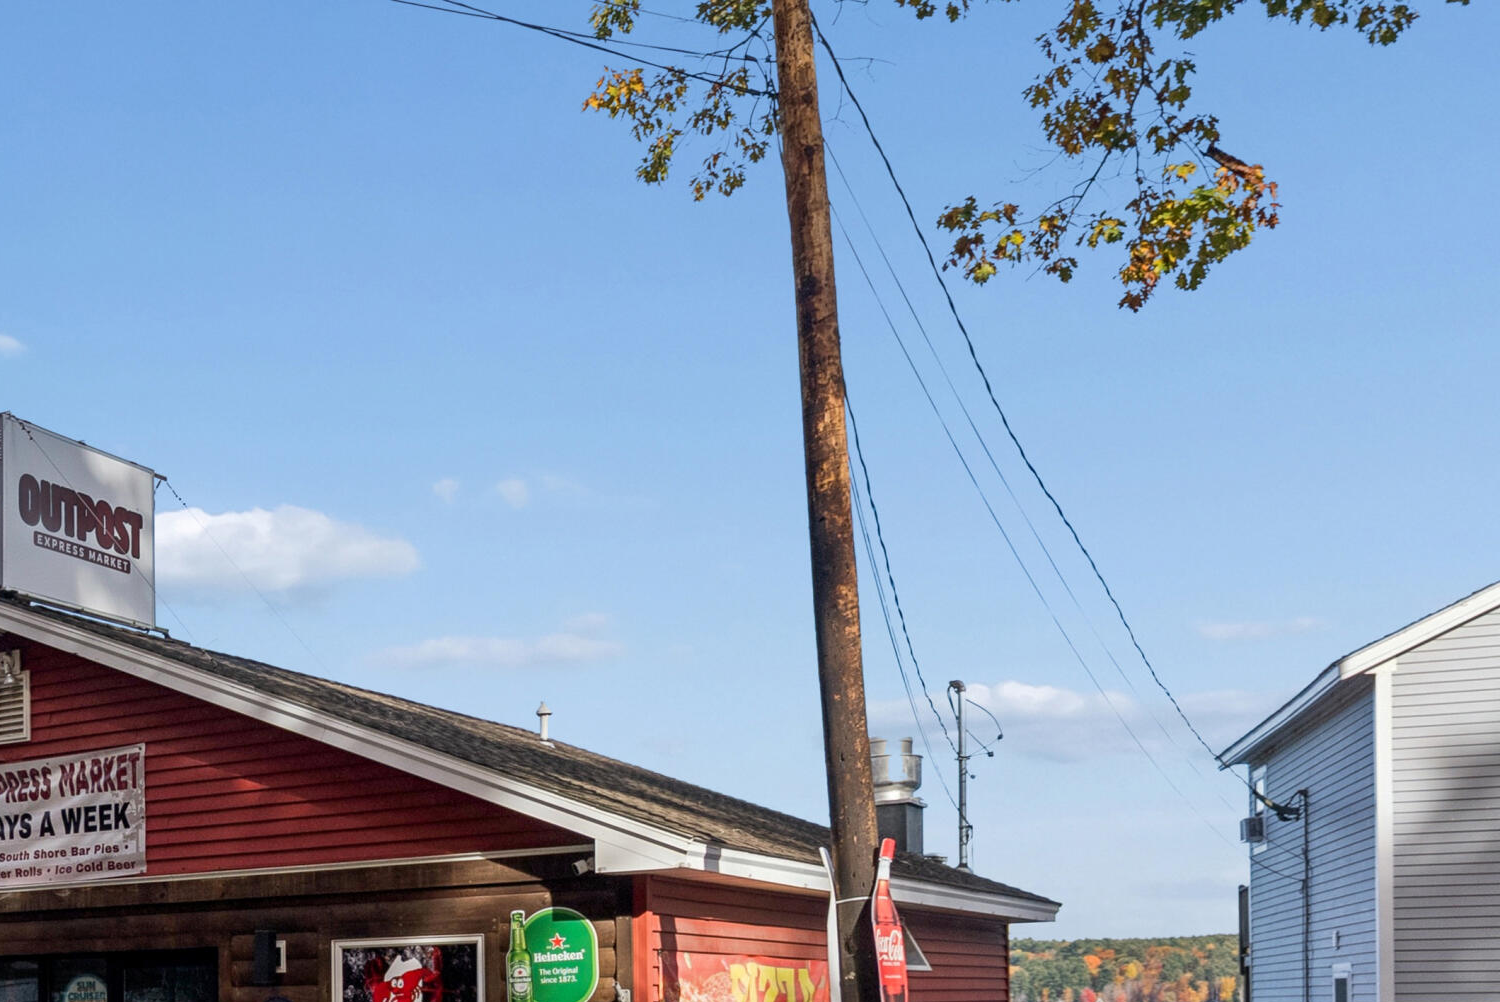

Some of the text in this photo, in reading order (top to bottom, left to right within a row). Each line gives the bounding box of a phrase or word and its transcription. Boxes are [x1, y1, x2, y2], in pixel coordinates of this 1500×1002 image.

[19, 473, 143, 560] OUTPOST
[36, 534, 130, 572] EXPRESS MARKET
[58, 752, 140, 797] MARKET
[40, 811, 56, 837] A
[61, 801, 131, 835] WEEK
[0, 850, 30, 862] South
[33, 847, 67, 860] Shore
[71, 846, 91, 857] Bar
[94, 842, 120, 855] Pies
[15, 866, 43, 878] Rolls
[55, 864, 73, 875] Ice
[76, 861, 104, 873] Cold
[107, 860, 136, 871] Beer
[533, 949, 586, 963] Heineken
[540, 966, 579, 976] The Original
[559, 975, 578, 983] 1873.
